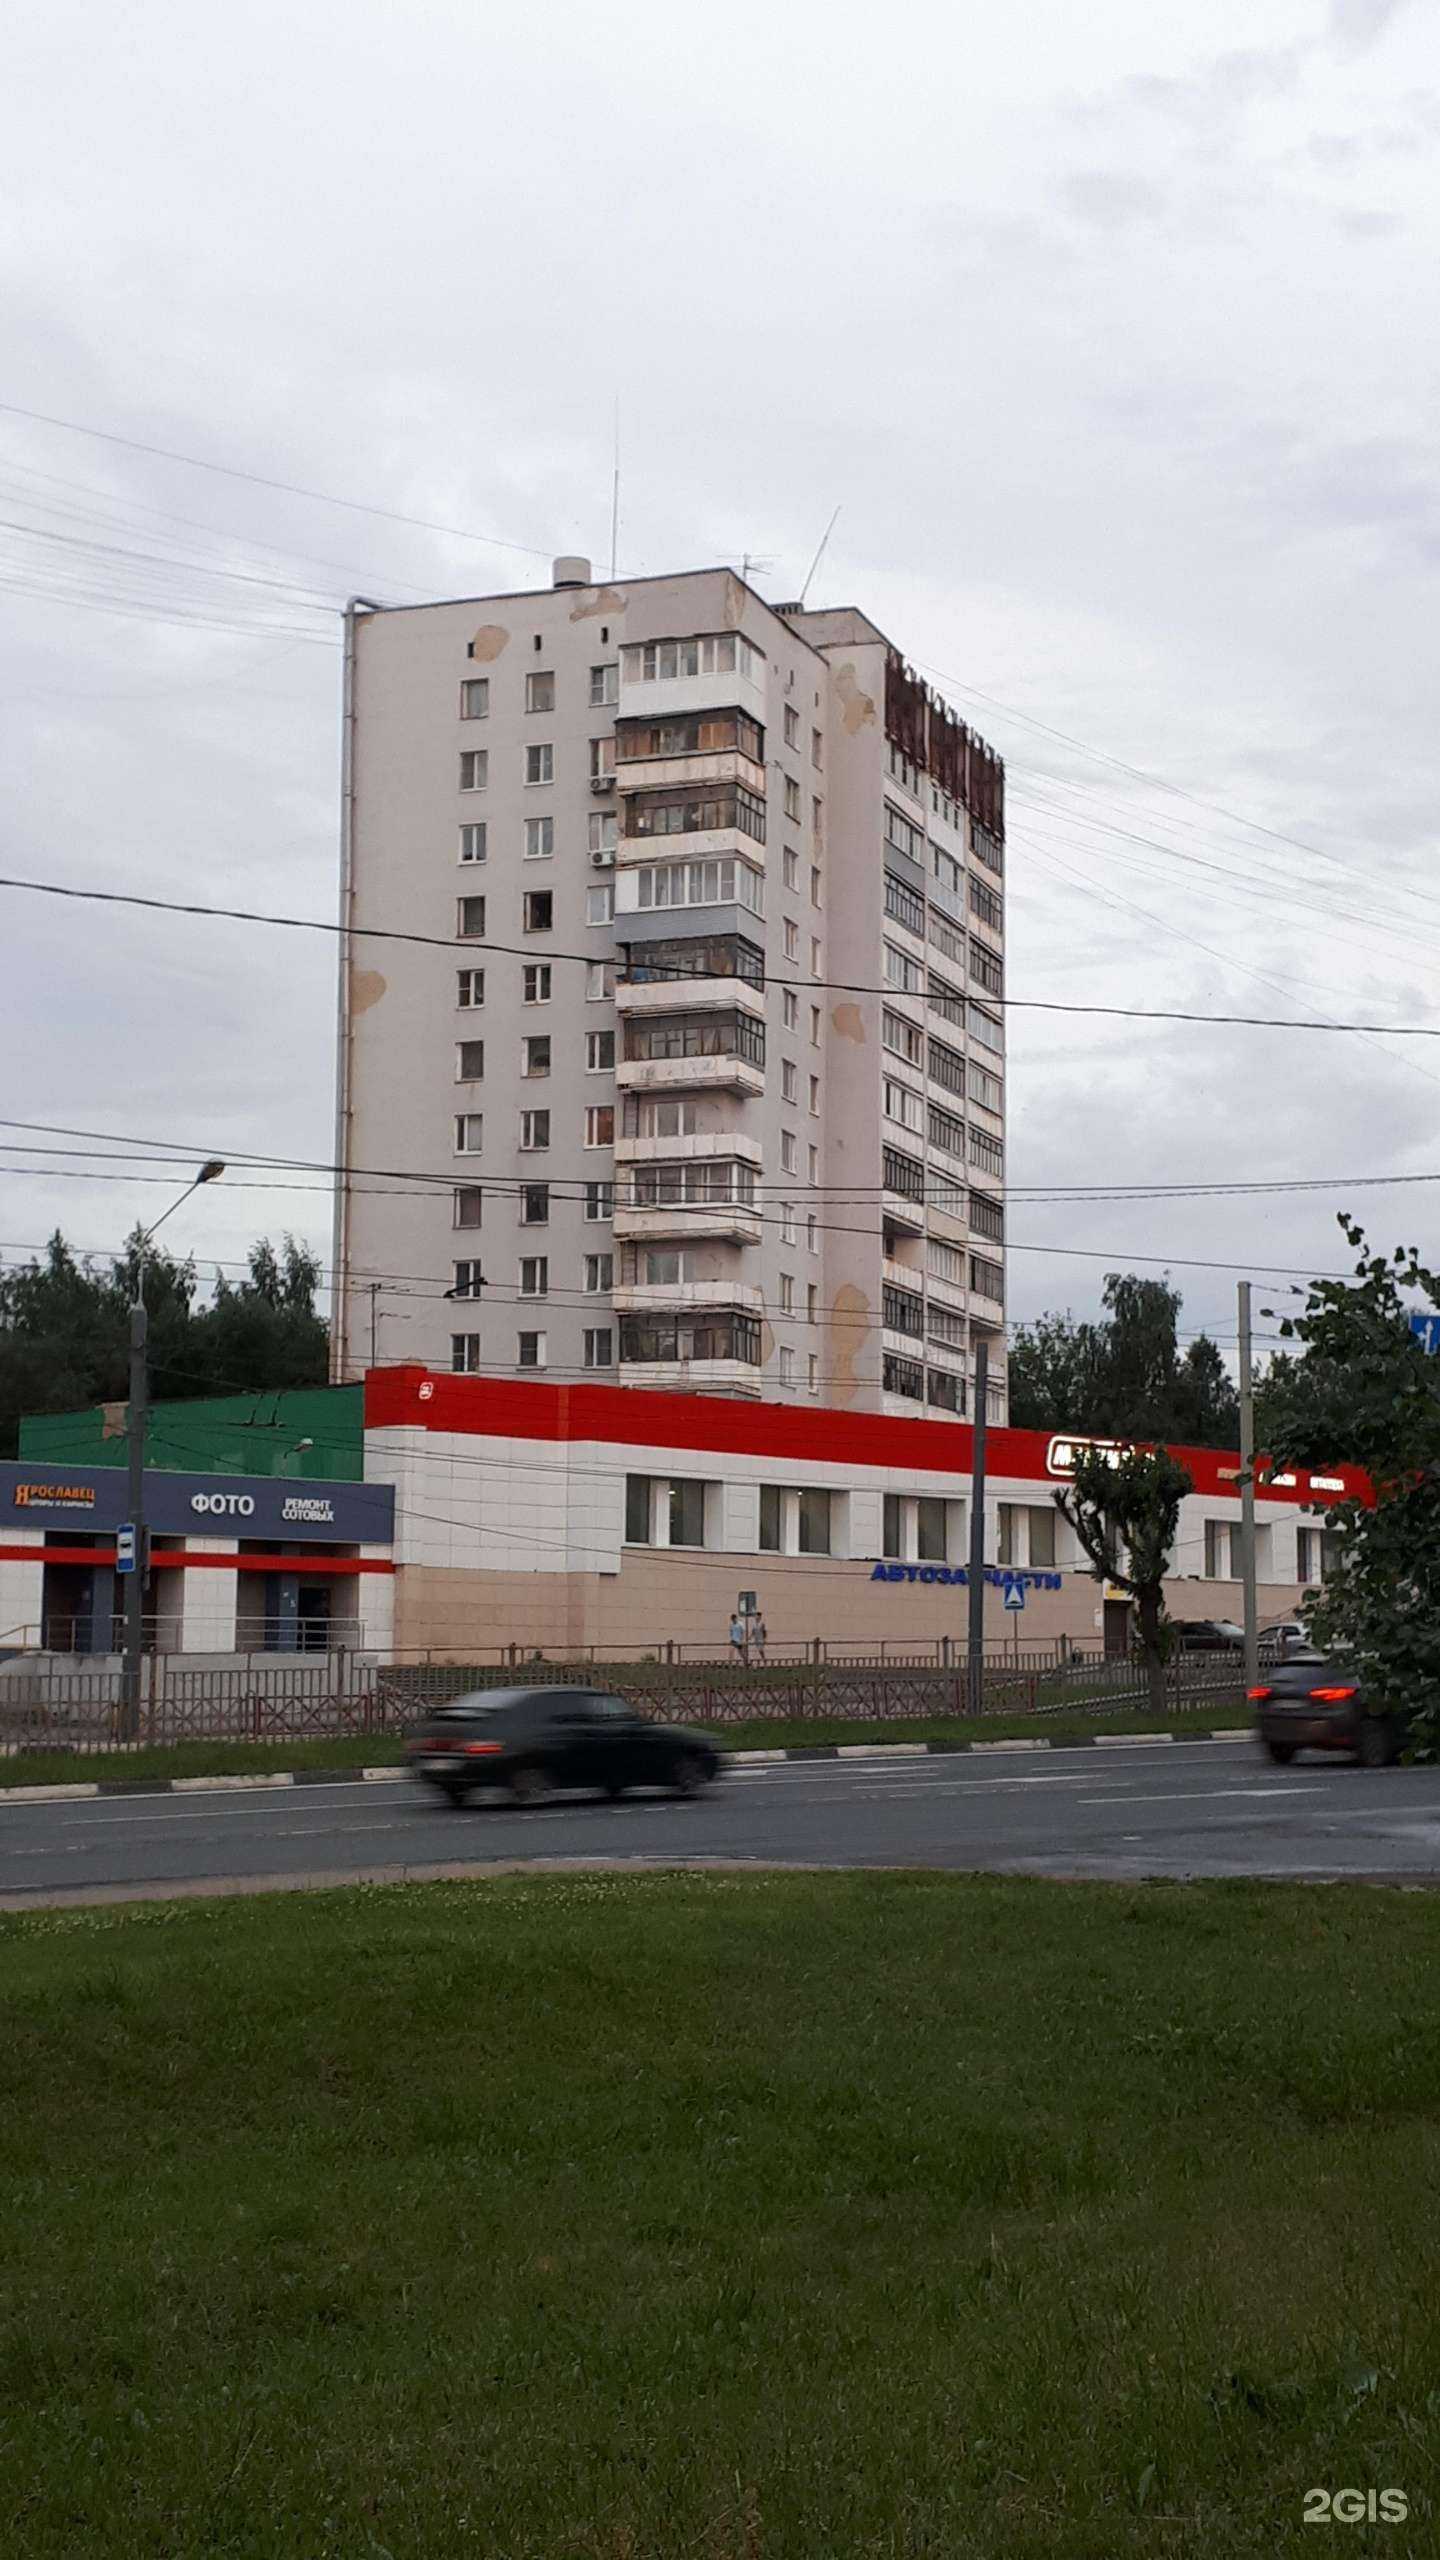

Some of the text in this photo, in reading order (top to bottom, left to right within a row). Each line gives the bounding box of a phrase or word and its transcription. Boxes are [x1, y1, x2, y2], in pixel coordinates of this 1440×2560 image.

[15, 1484, 95, 1505] ЯРОСЛАВЕЦ
[190, 1493, 255, 1516] ФОТО
[284, 1498, 331, 1511] РЕМОНТ
[282, 1508, 334, 1522] СОТОВЫХ
[870, 1563, 1062, 1590] АВТОЗАЧАСТИ
